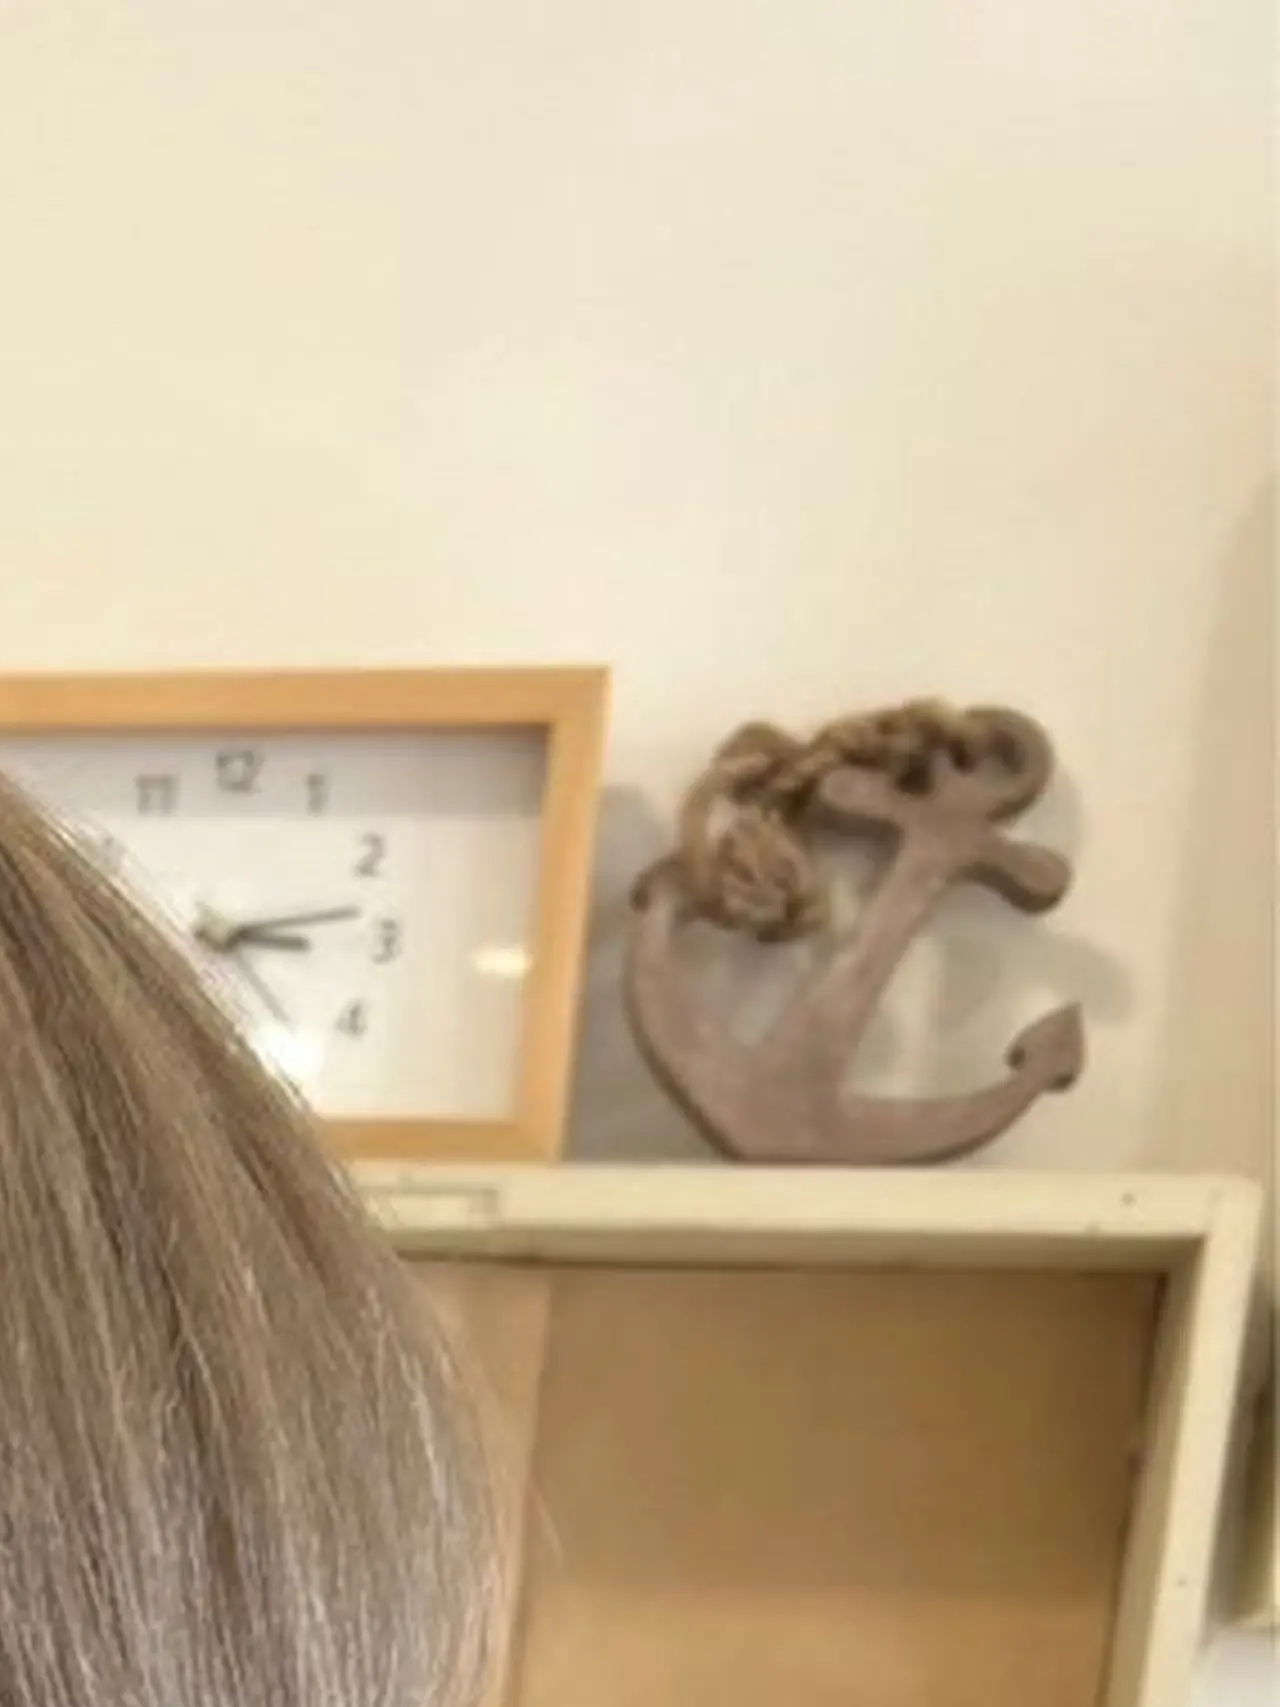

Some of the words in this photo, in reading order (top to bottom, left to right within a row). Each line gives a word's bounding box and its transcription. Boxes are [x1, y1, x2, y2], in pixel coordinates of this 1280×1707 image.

[354, 834, 386, 878] 2
[372, 919, 400, 964] 3
[334, 999, 367, 1041] 4
